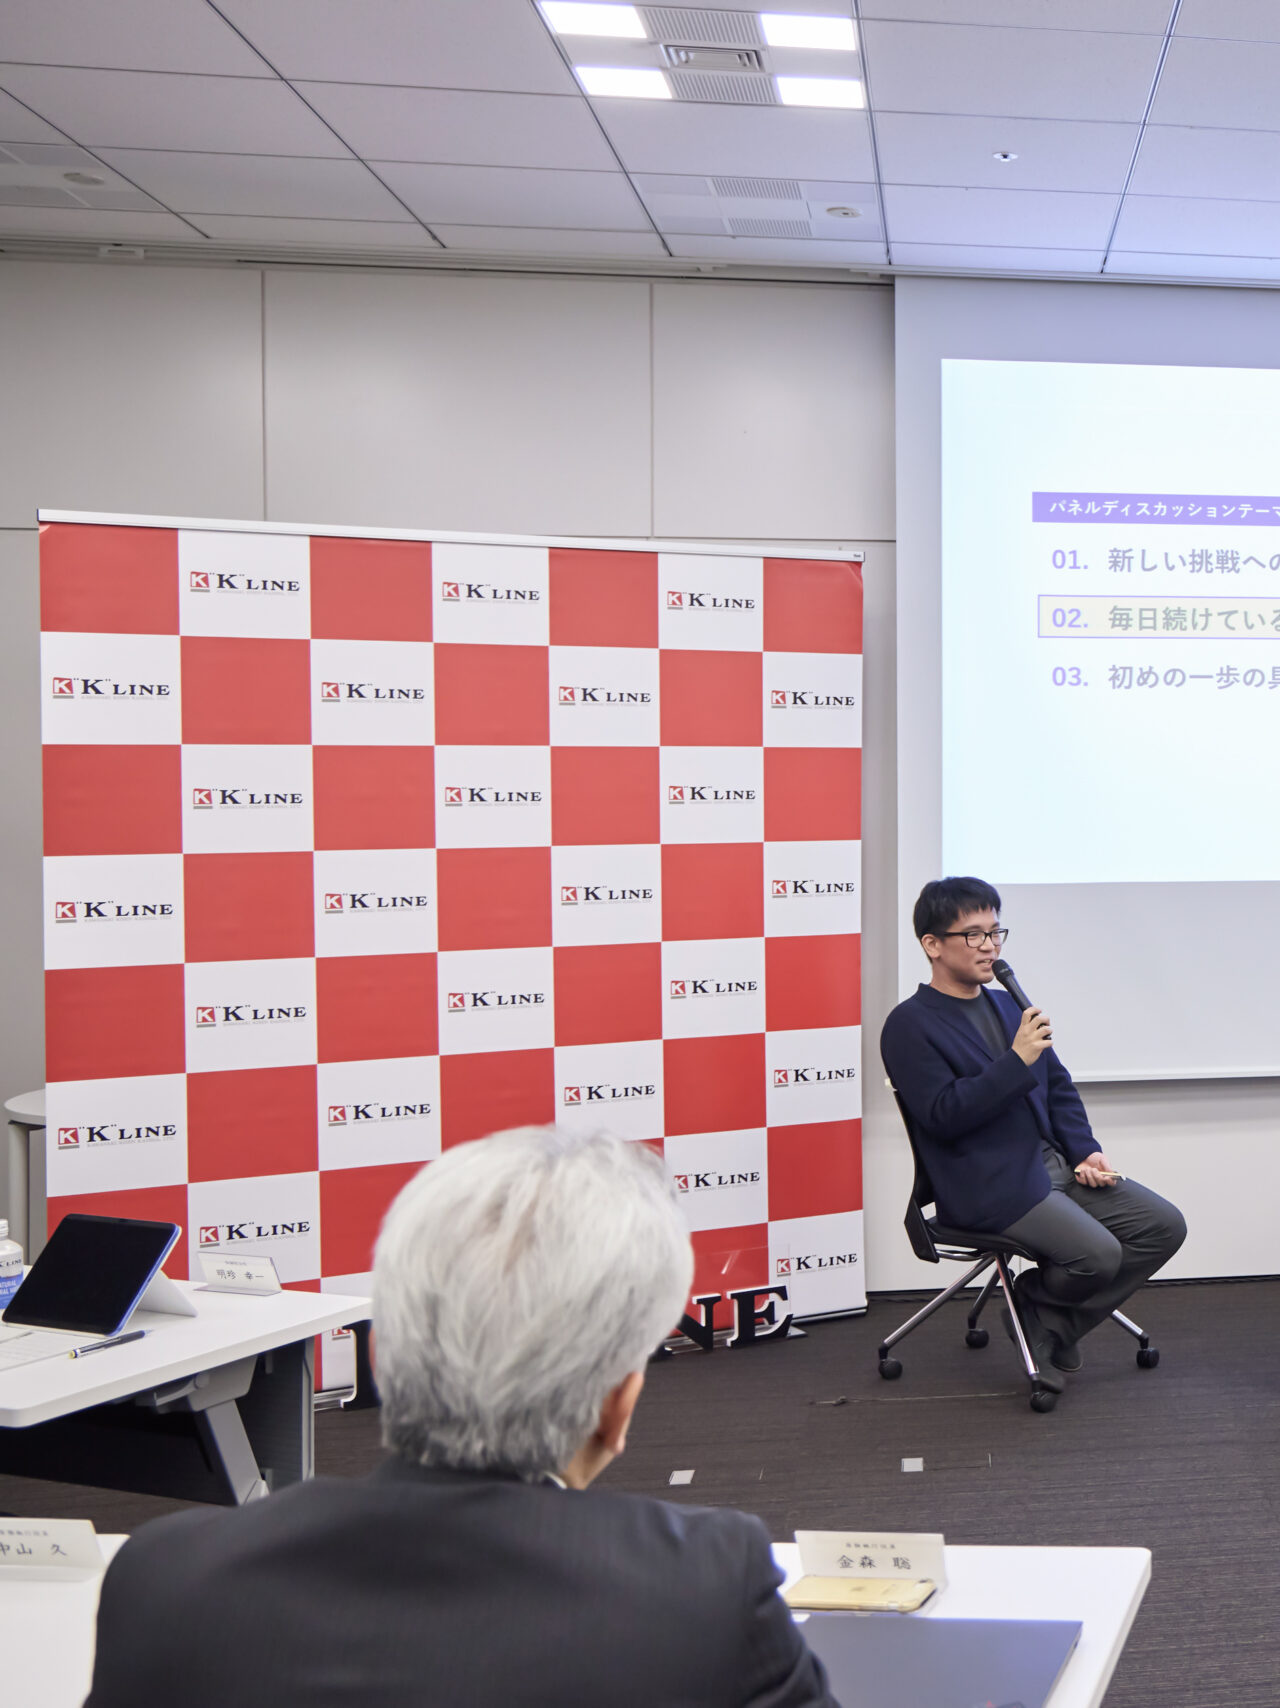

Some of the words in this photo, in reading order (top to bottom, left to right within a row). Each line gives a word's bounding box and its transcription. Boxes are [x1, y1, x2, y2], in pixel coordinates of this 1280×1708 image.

[1051, 549, 1089, 570] 01.
[193, 573, 208, 586] K
[246, 579, 299, 591] LINE
[444, 583, 458, 596] K
[492, 589, 539, 600] LINE
[669, 592, 681, 604] K
[712, 598, 755, 608] LINE
[1051, 608, 1089, 629] 02.
[1051, 667, 1089, 688] 03.
[54, 679, 72, 693] K
[113, 684, 170, 695] LINE
[324, 683, 338, 696] K
[374, 688, 424, 699] LINE
[561, 688, 574, 700] K
[606, 692, 651, 702] LINE
[774, 691, 785, 703] K
[814, 696, 854, 706] LINE
[194, 789, 211, 803] K
[249, 794, 302, 804] LINE
[447, 788, 461, 801] K
[494, 792, 542, 802] LINE
[671, 787, 682, 799] K
[714, 790, 755, 800] LINE
[563, 888, 576, 900] K
[608, 889, 653, 900] LINE
[774, 881, 785, 893] K
[815, 883, 854, 893] LINE
[327, 895, 341, 908] K
[377, 896, 427, 907] LINE
[57, 903, 75, 917] K
[116, 904, 173, 916] LINE
[672, 982, 684, 994] K
[716, 981, 757, 992] LINE
[449, 994, 463, 1007] K
[497, 993, 544, 1005] LINE
[198, 1008, 214, 1021] K
[252, 1007, 306, 1020] LINE
[776, 1071, 787, 1082] K
[816, 1068, 855, 1080] LINE
[566, 1088, 579, 1100] K
[611, 1085, 655, 1098] LINE
[329, 1107, 345, 1120] K
[381, 1104, 431, 1117] LINE
[59, 1129, 78, 1143] K
[119, 1125, 176, 1140] LINE
[718, 1172, 760, 1185] LINE
[201, 1227, 217, 1242] K
[256, 1222, 310, 1237] LINE
[778, 1260, 789, 1271] K
[818, 1253, 857, 1267] LINE
[50, 1544, 68, 1556] 久
[838, 1554, 876, 1569] 金森
